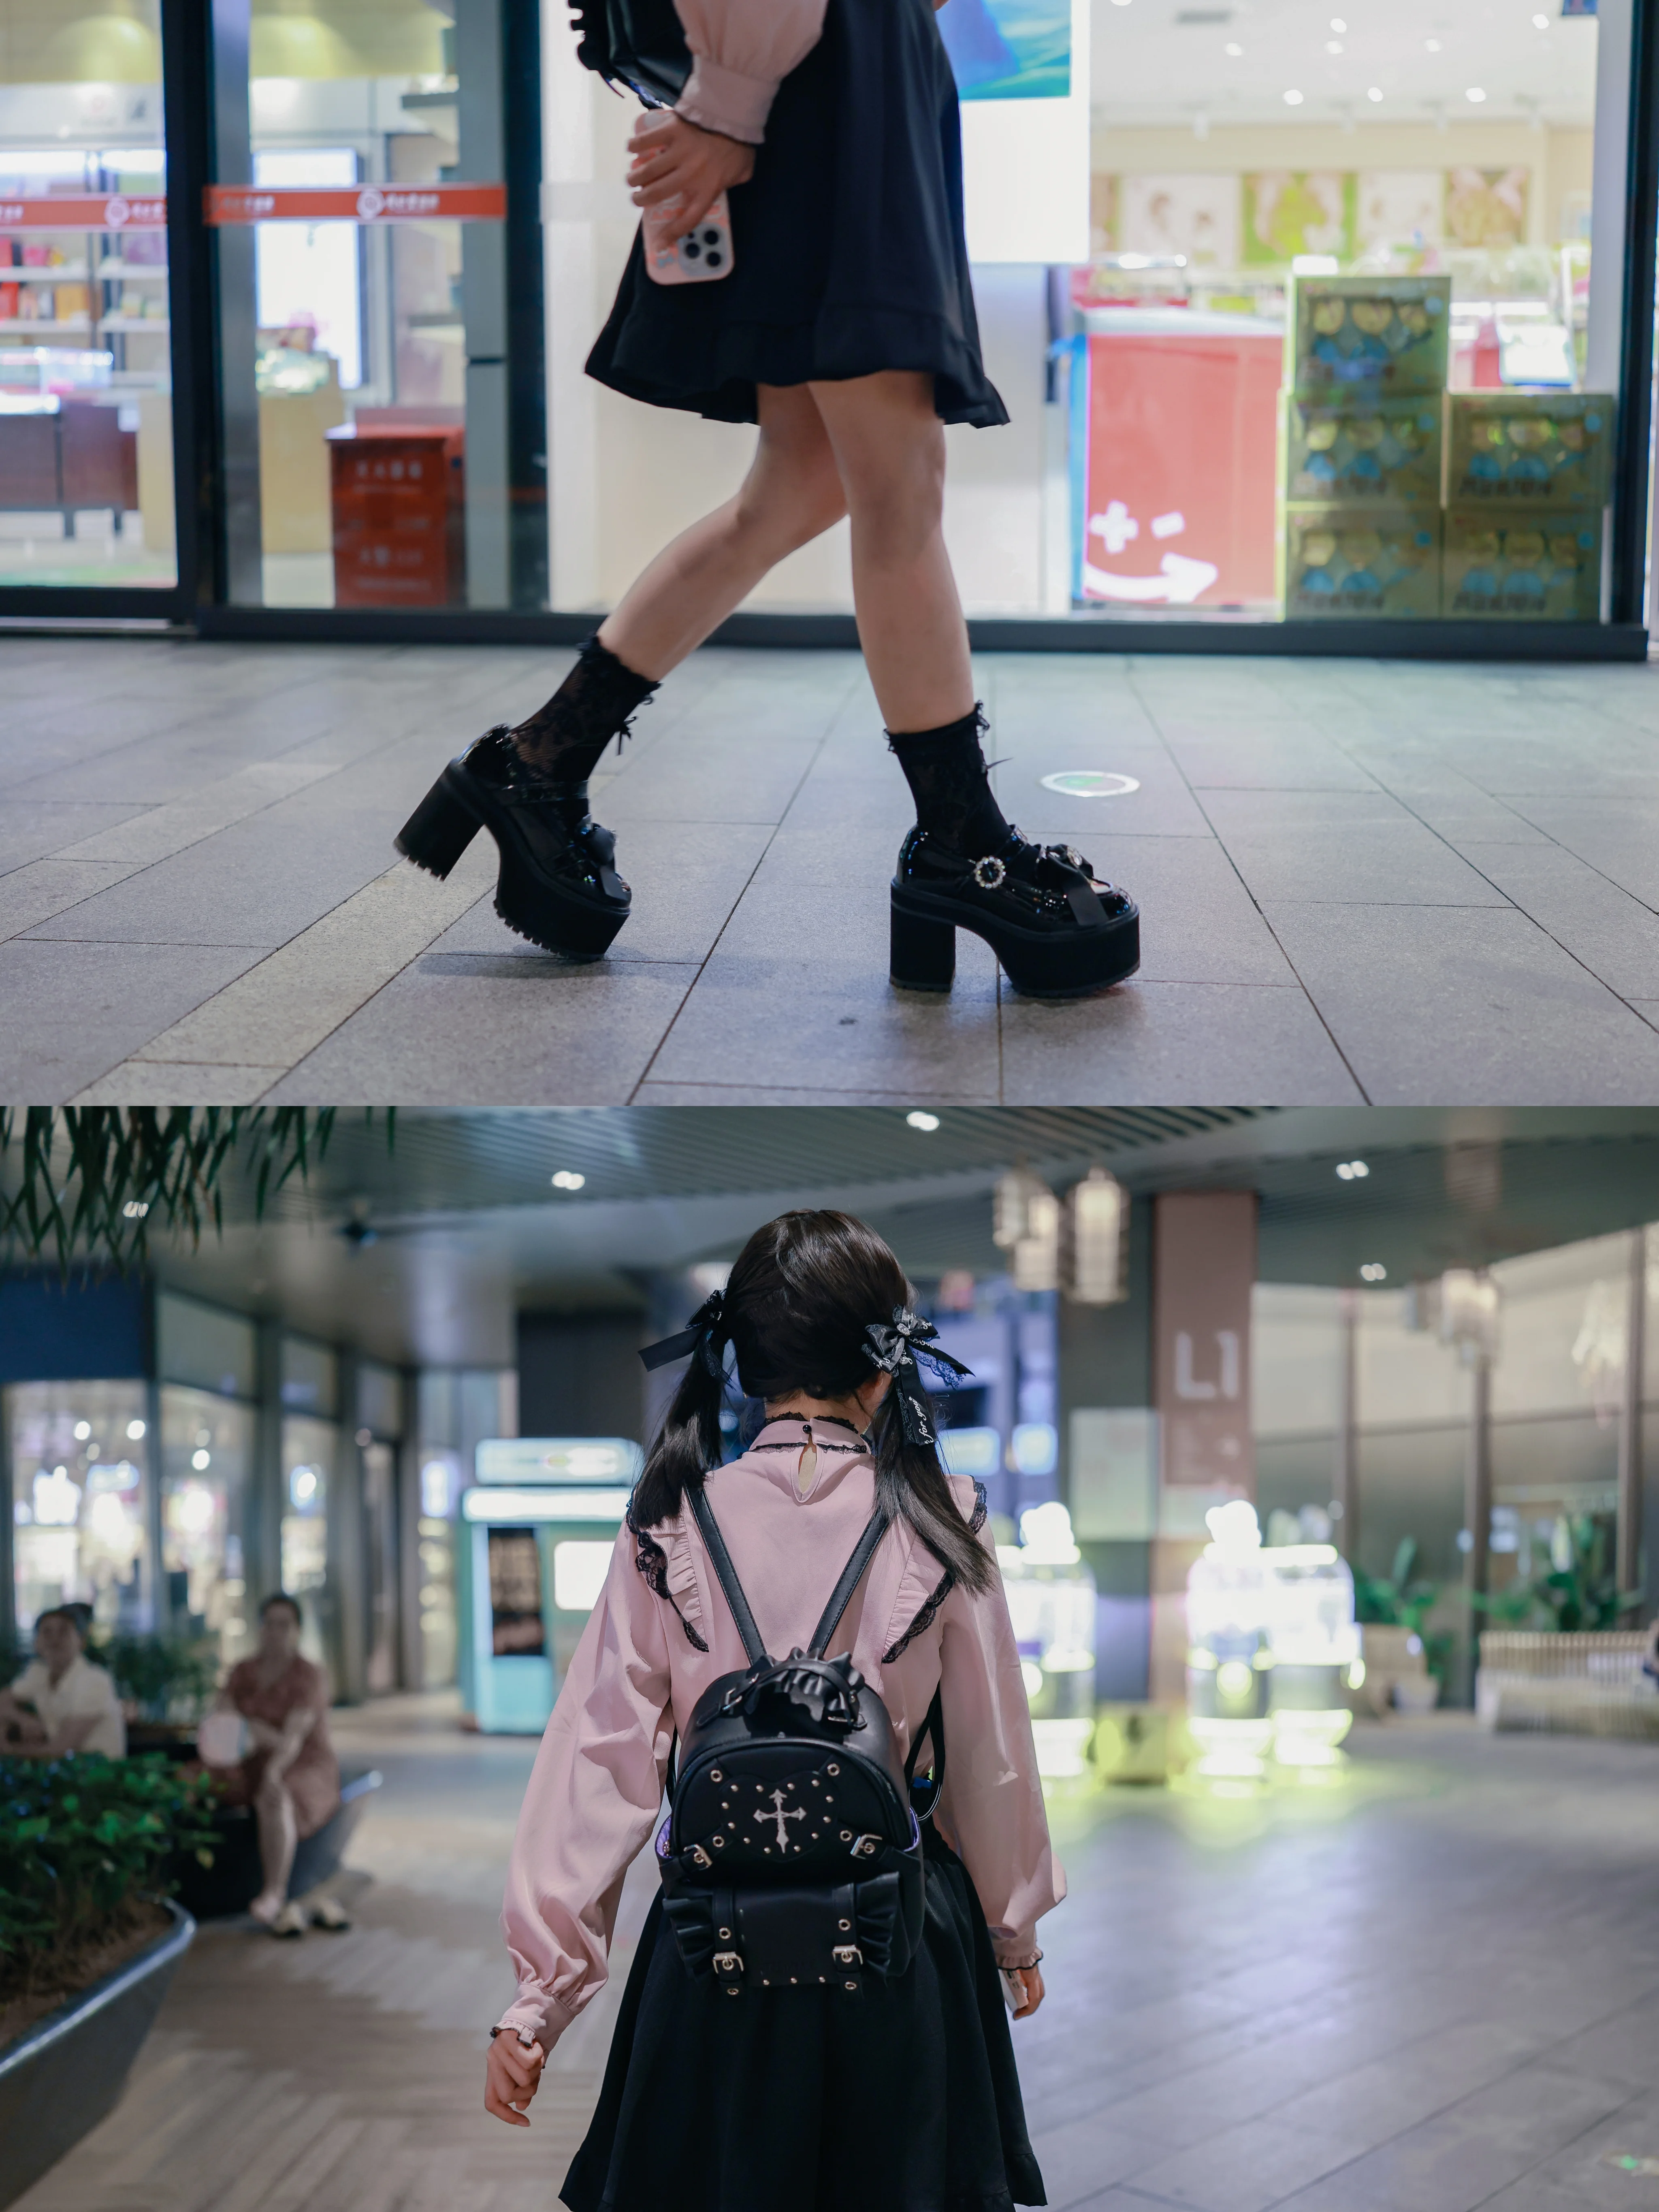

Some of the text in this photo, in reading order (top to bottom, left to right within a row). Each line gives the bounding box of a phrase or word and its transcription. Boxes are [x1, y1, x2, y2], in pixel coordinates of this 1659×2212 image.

[1175, 1331, 1239, 1399] L1
[912, 1398, 927, 1421] you
[919, 1420, 934, 1443] for
